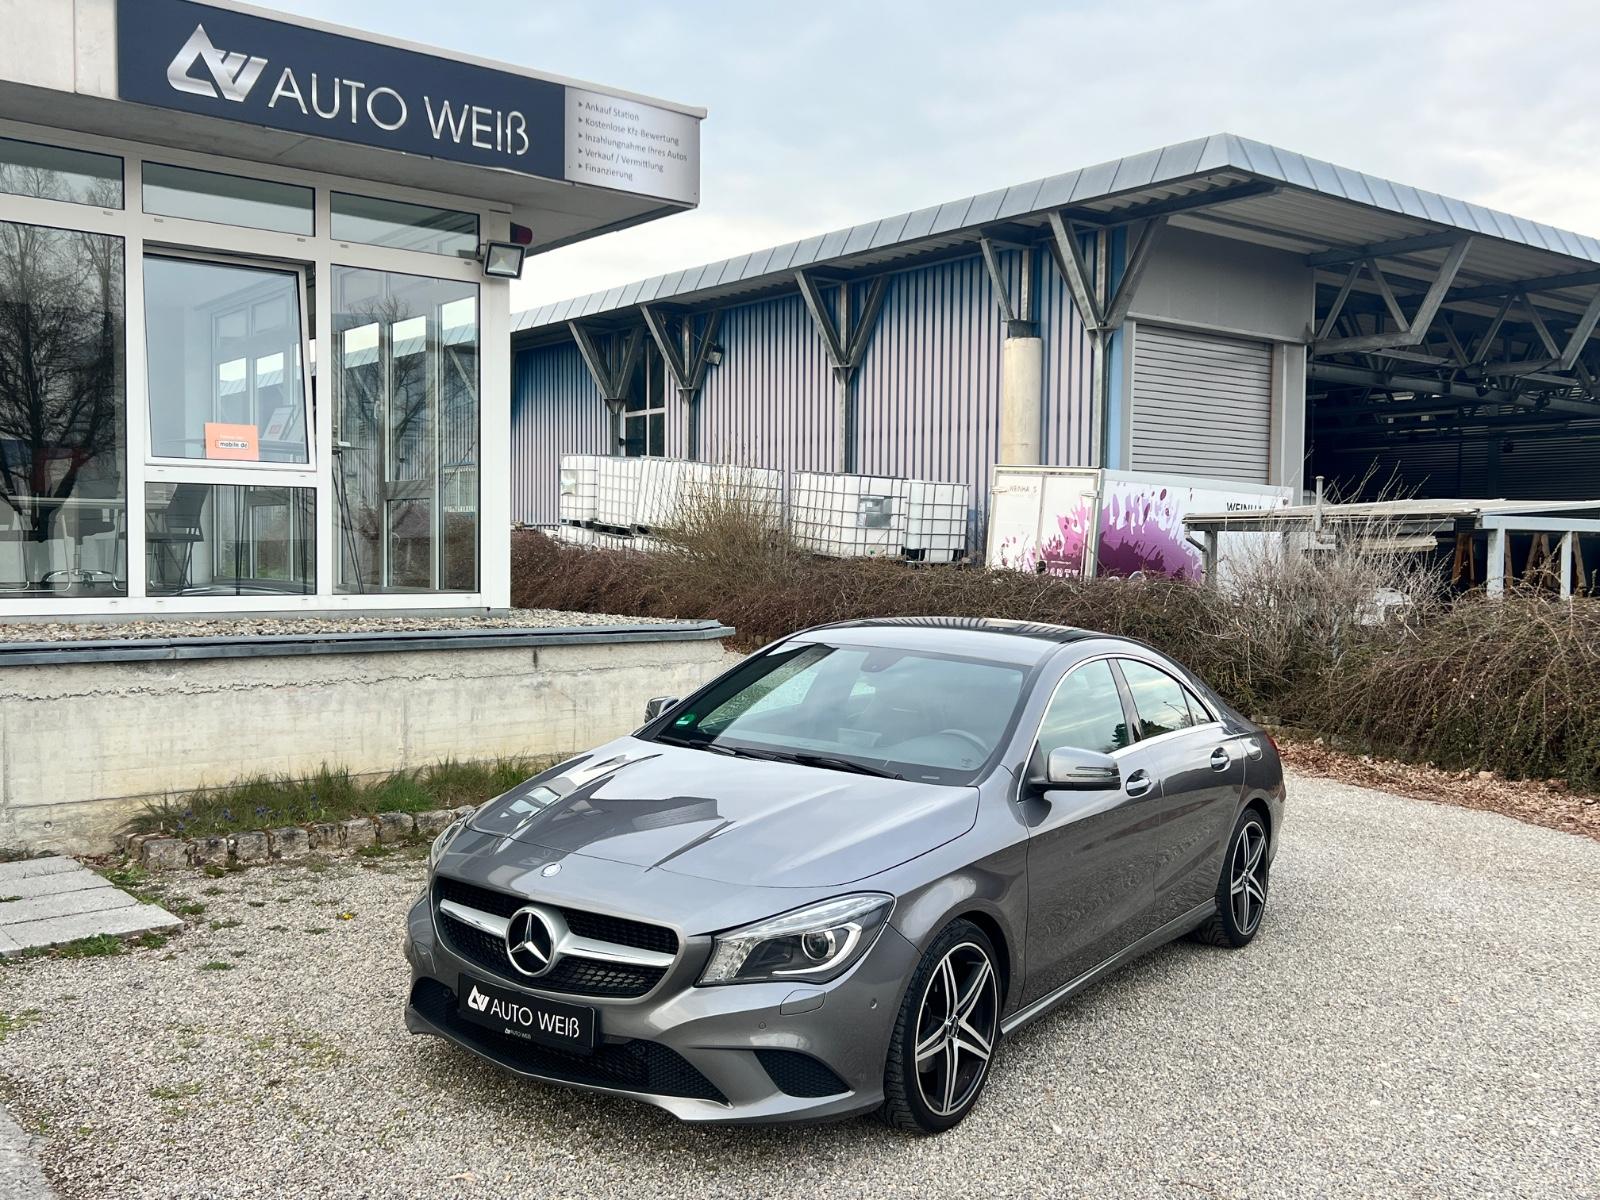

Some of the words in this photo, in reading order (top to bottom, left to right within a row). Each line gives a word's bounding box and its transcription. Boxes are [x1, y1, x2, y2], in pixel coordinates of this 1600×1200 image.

[268, 67, 408, 131] AUTO
[424, 96, 529, 156] WEIß
[585, 102, 612, 116] Ankauf
[613, 108, 639, 121] Station
[585, 118, 625, 134] Kostenlose
[640, 129, 679, 146] Bewertung
[585, 133, 646, 153] Inzahlungnahme
[648, 147, 666, 157] Ihres
[667, 151, 688, 161] Autos
[585, 148, 614, 161] Verkauf
[621, 156, 664, 173] Vermittlung
[585, 163, 633, 181] Finanzierung
[490, 999, 533, 1026] AUTO
[537, 1011, 580, 1038] WEIß
